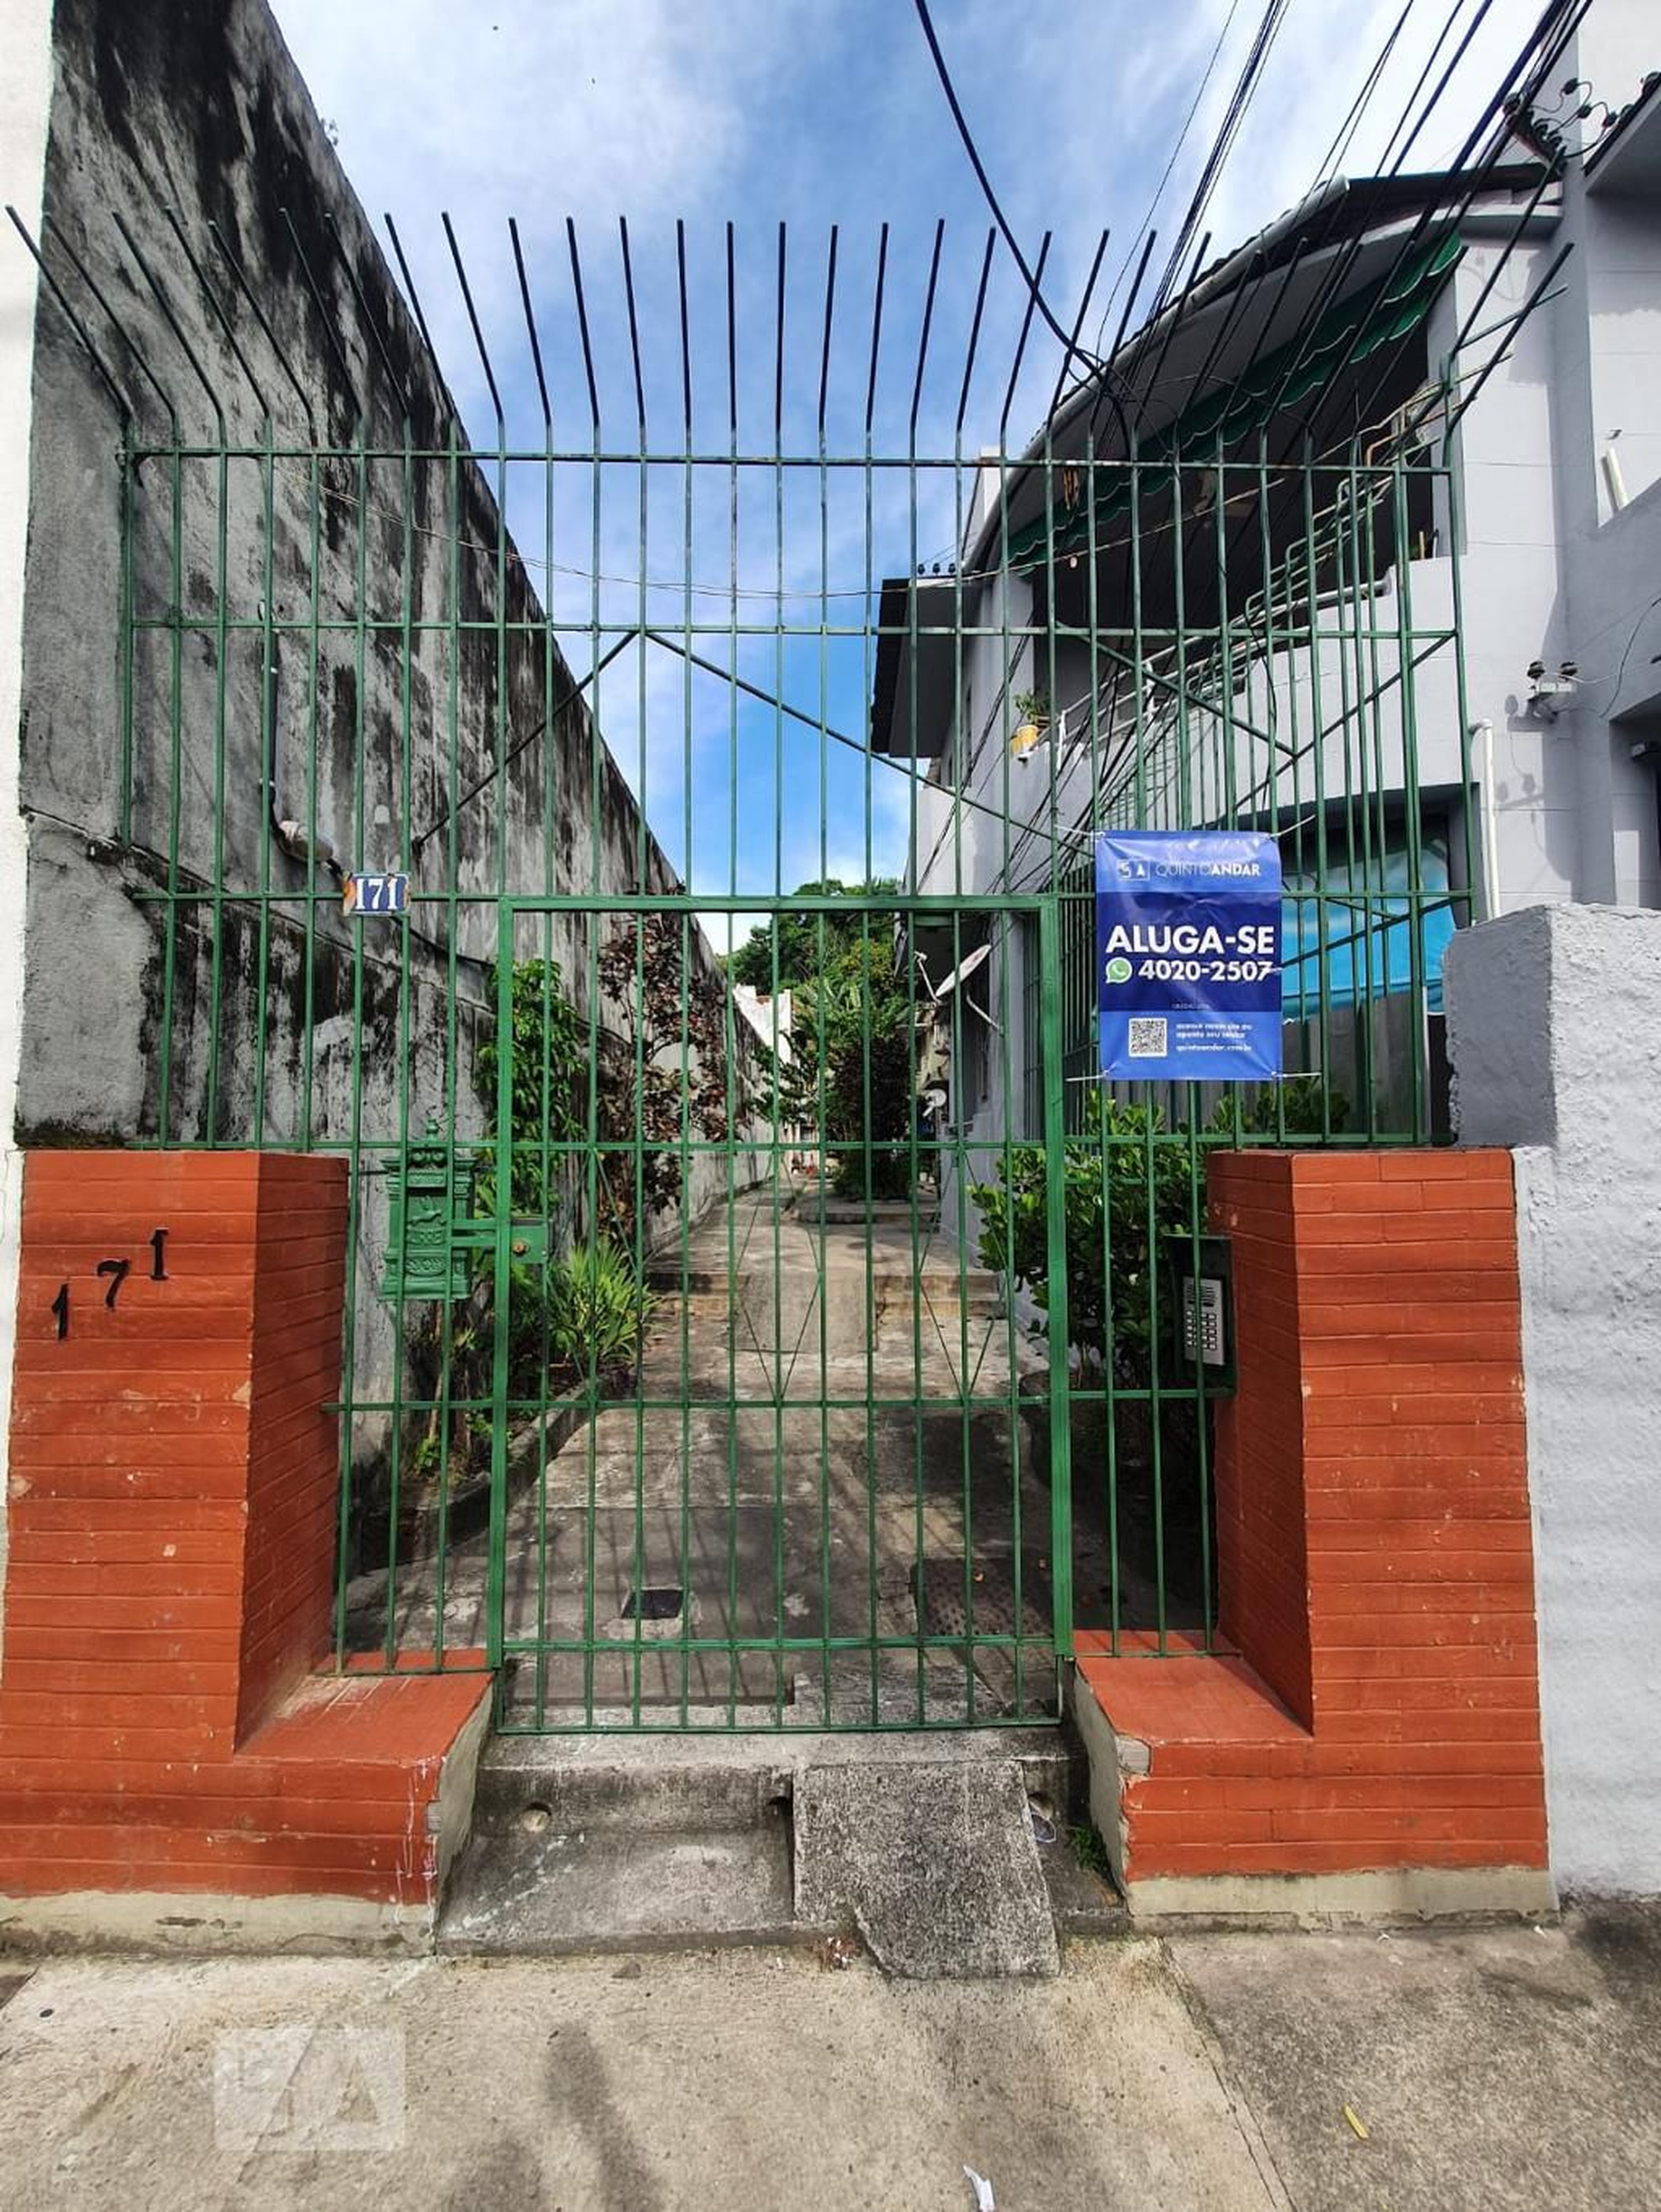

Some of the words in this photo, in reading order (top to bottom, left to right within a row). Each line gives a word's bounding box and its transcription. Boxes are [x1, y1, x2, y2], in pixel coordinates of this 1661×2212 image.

[1156, 863, 1260, 877] QUINTOANDAR
[356, 879, 398, 909] 171
[1106, 925, 1274, 954] ALUGA-SE
[1138, 959, 1273, 981] 4020-2507
